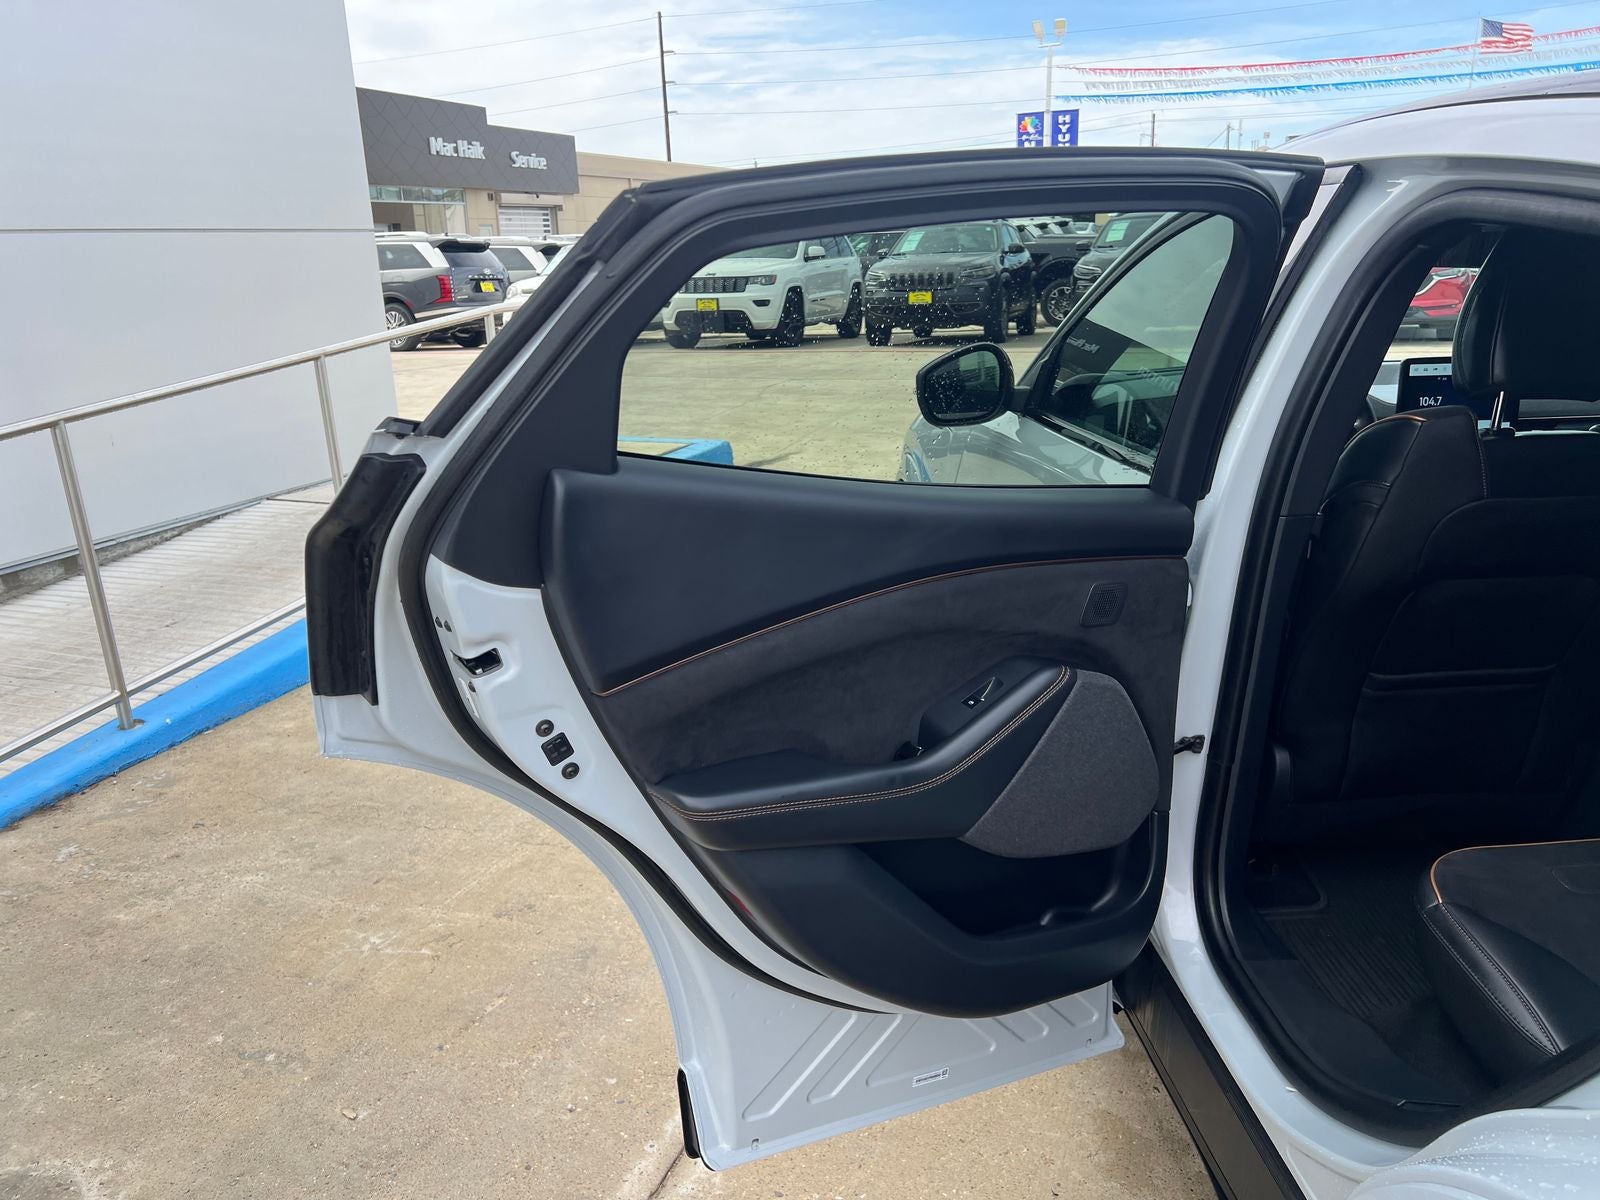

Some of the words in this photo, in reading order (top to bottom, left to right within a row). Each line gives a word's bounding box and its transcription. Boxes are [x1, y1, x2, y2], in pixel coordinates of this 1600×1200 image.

[429, 137, 457, 157] Mac
[457, 139, 486, 160] Haik
[510, 151, 548, 170] Service
[1419, 396, 1442, 406] 104.7
